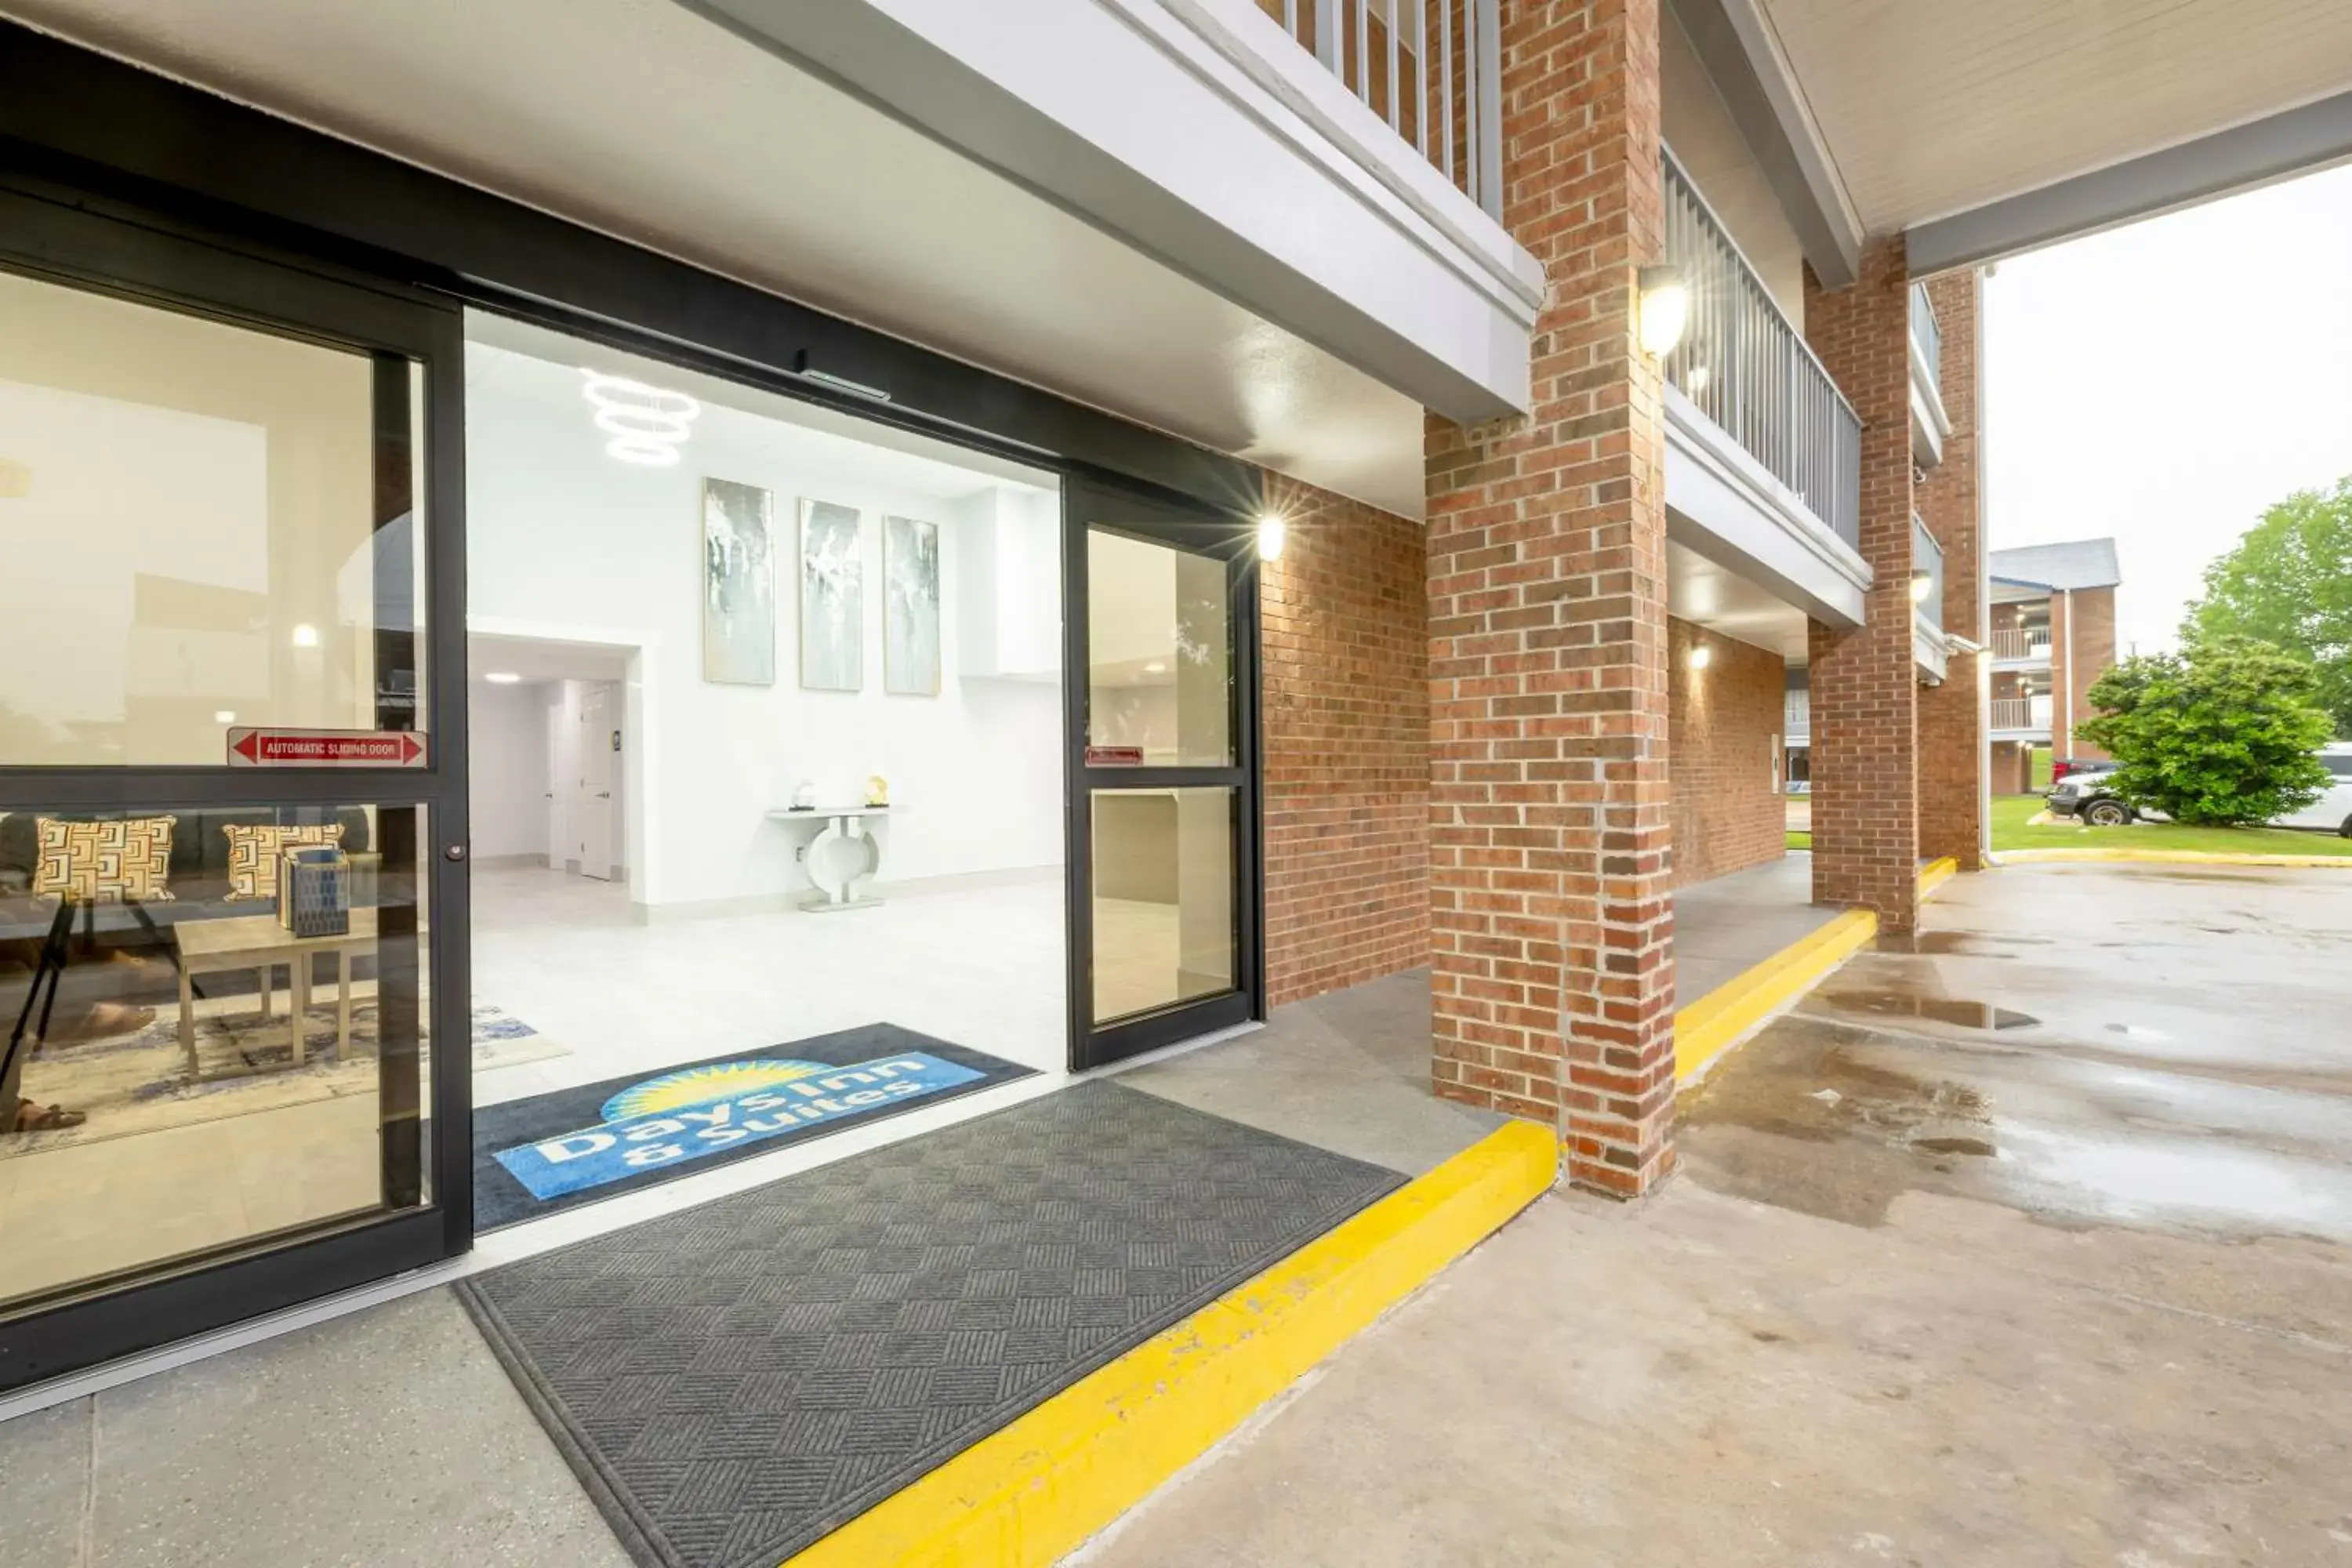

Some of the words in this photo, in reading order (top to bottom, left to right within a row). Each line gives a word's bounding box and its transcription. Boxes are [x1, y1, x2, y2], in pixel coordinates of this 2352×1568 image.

[267, 742, 325, 754] AUTOMATIC
[328, 743, 366, 755] SLIDING
[369, 744, 395, 755] DOOR
[535, 1093, 786, 1163] Days
[787, 1060, 927, 1097] Inn
[622, 1142, 684, 1167] &
[696, 1080, 924, 1146] Suites
